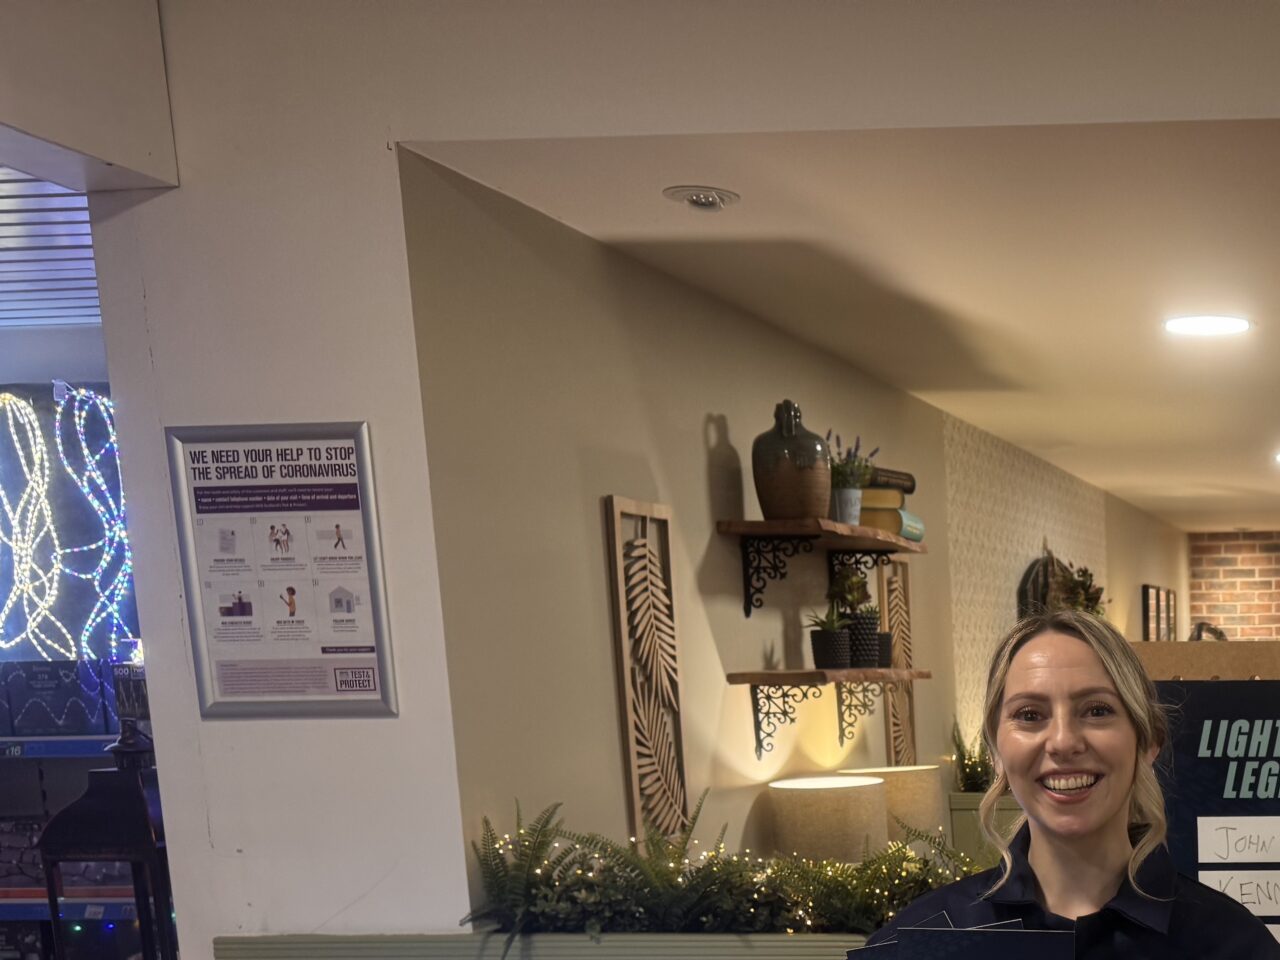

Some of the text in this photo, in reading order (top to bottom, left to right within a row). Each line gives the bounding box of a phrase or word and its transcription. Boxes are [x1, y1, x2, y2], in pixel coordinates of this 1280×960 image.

[189, 446, 354, 464] WE NEED YOUR HELP TO STOP
[191, 463, 356, 481] THE SPREAD OF CORONAVIRUS
[340, 679, 371, 689] PROTECT
